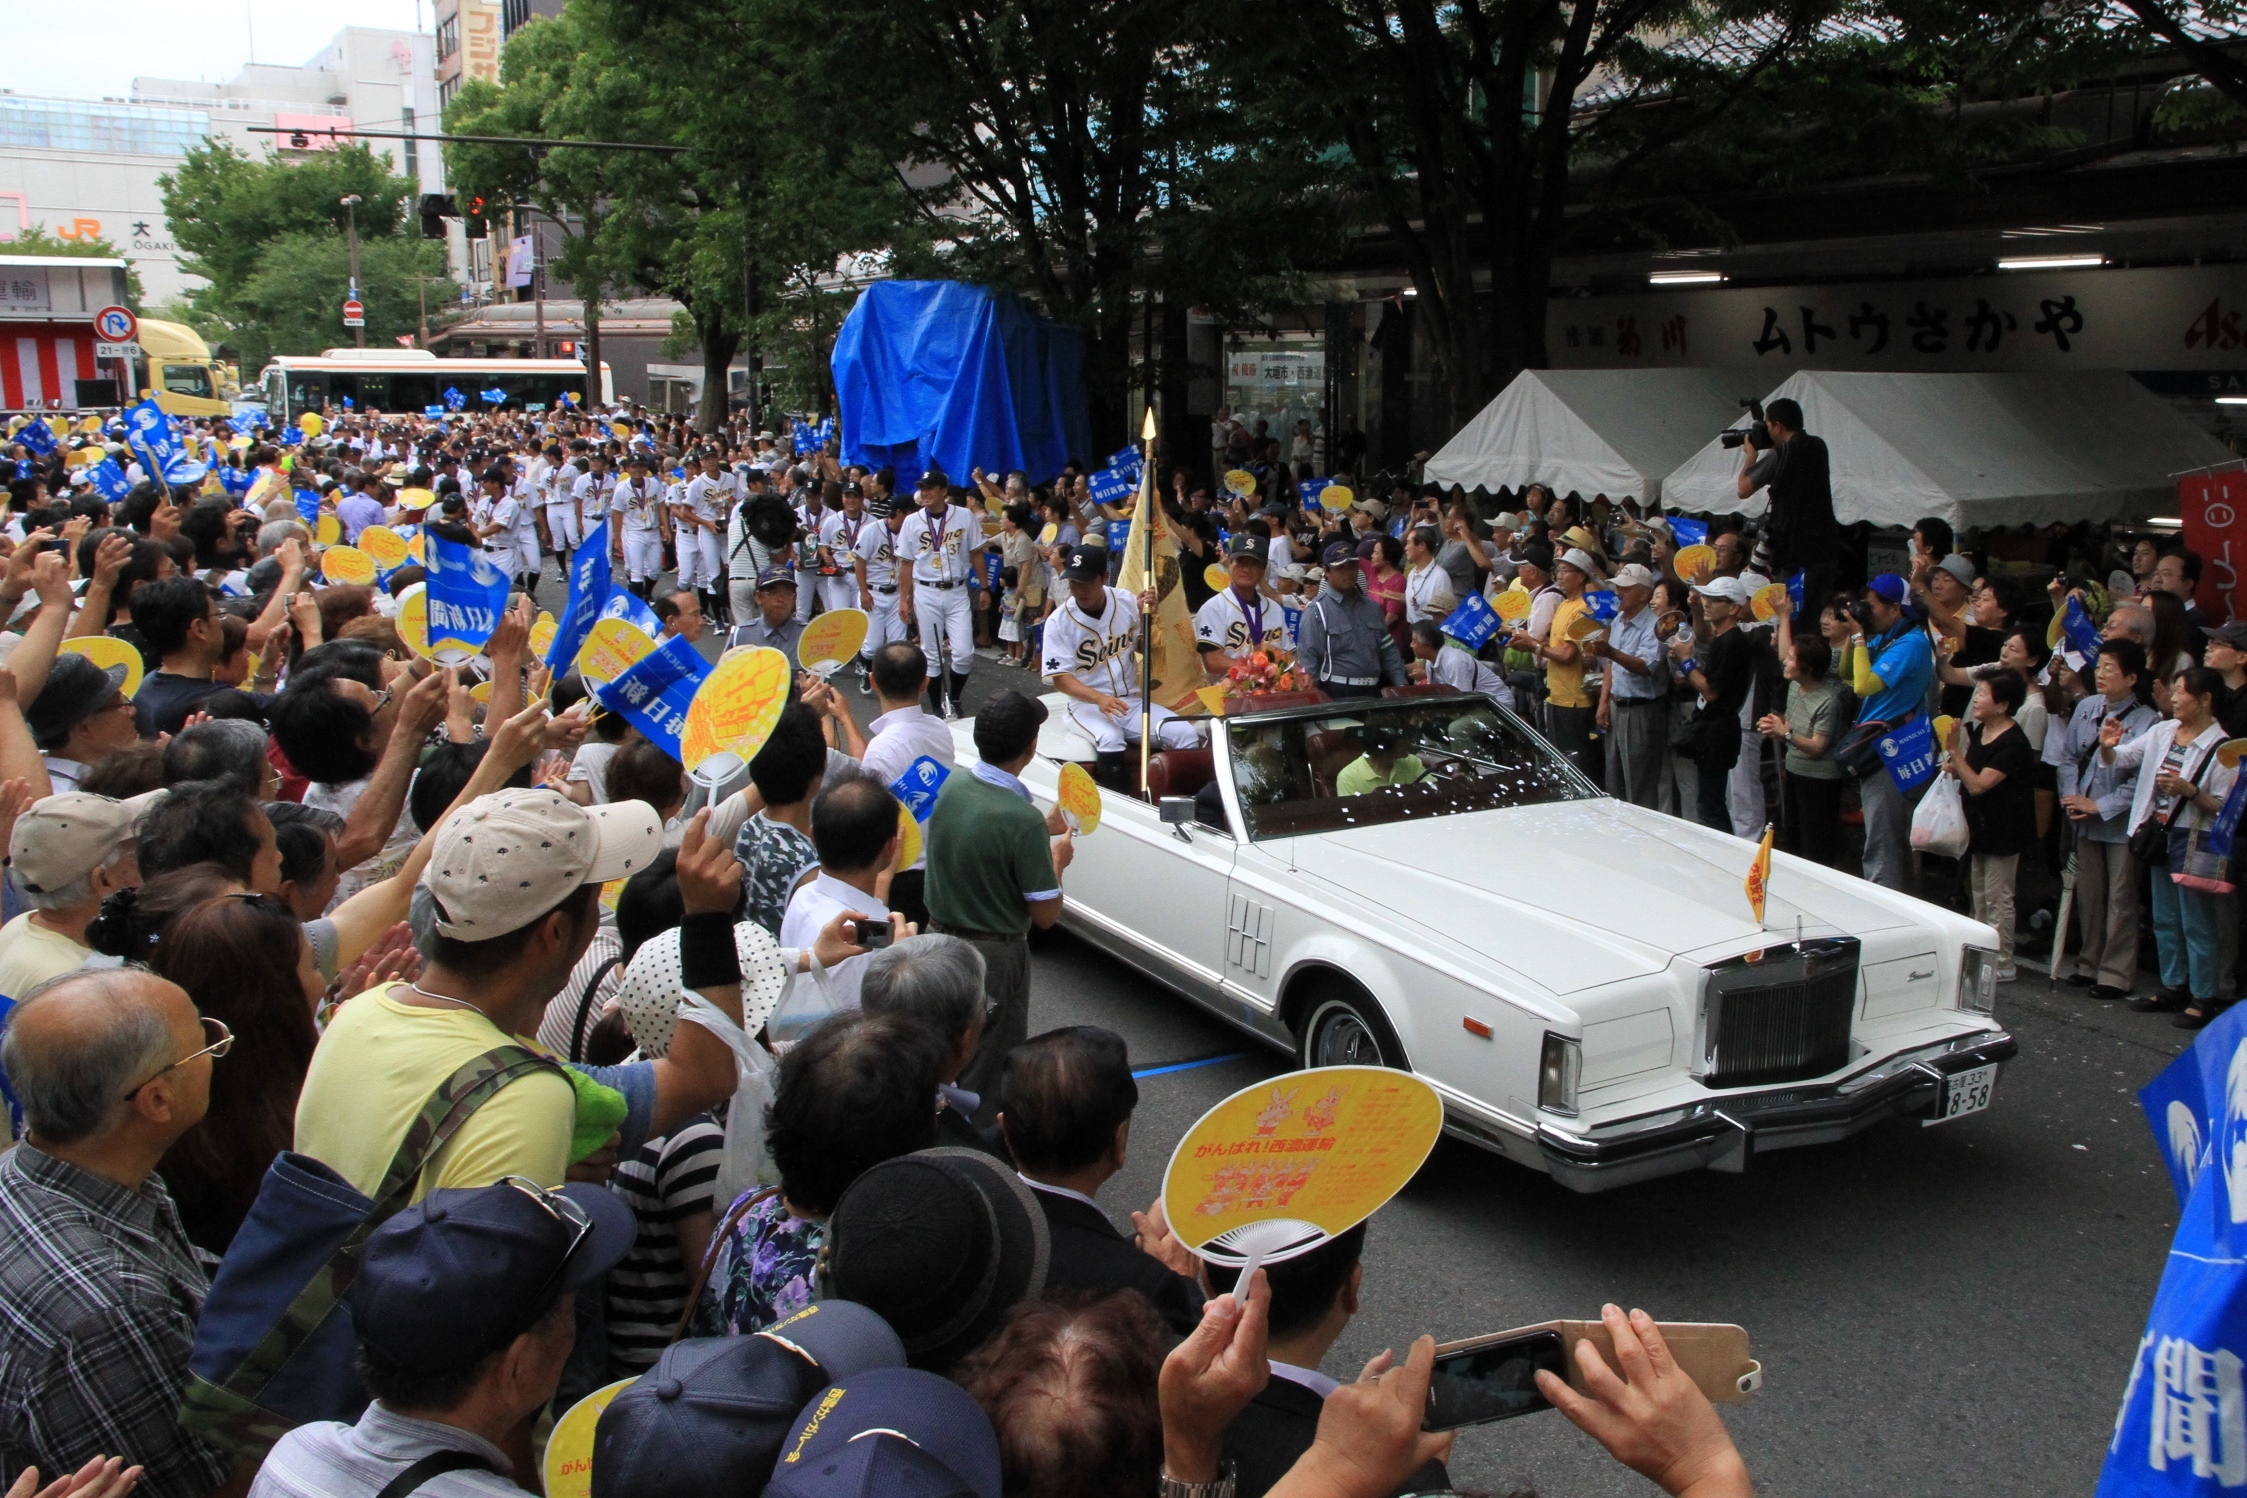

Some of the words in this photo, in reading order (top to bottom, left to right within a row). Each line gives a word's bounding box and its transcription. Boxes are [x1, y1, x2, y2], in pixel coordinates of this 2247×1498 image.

[57, 218, 100, 241] JR
[133, 221, 150, 237] 大
[1752, 296, 2084, 357] ムトウさかや
[2184, 297, 2247, 350] As
[2208, 375, 2247, 389] SA
[1244, 538, 1255, 550] S
[1072, 554, 1082, 567] S
[1967, 1071, 1983, 1086] 33
[2111, 1329, 2247, 1488] 聞
